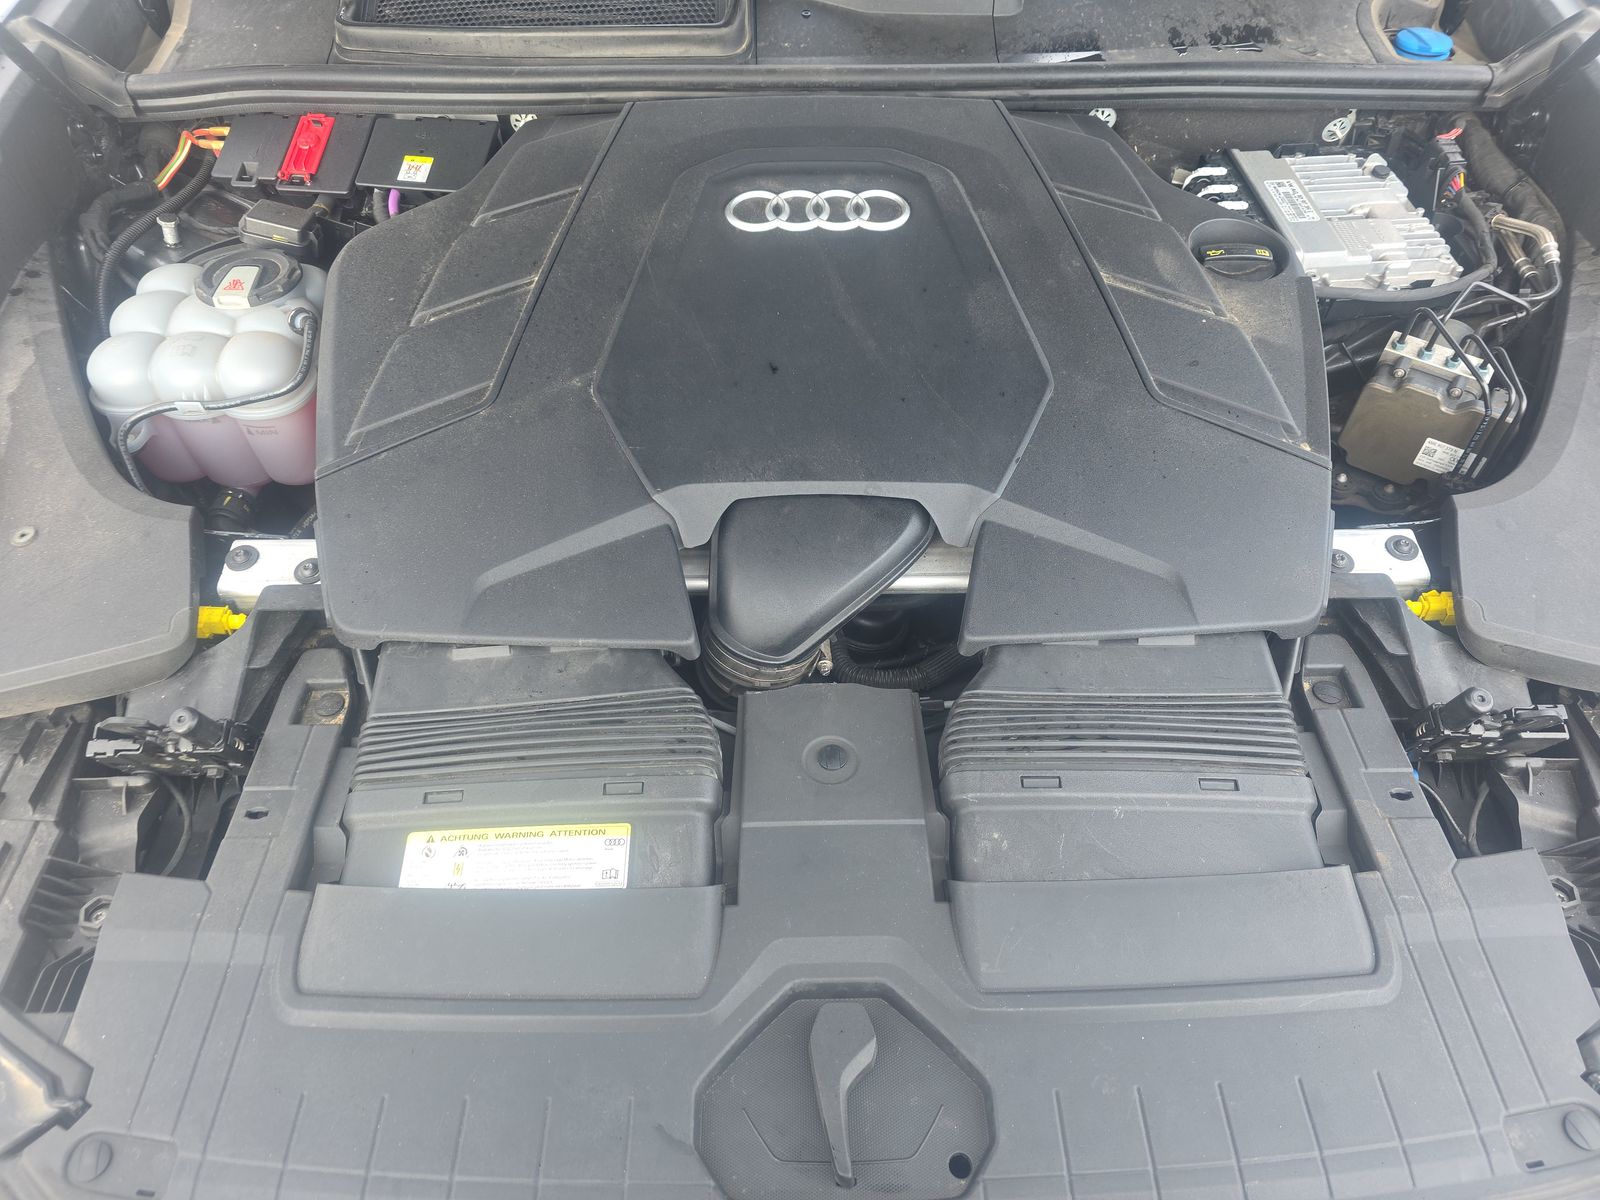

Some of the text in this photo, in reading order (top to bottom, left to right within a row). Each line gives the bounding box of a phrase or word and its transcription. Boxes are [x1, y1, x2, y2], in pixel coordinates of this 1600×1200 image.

[440, 828, 607, 842] ACHTUNG WARNING ATTENTION
